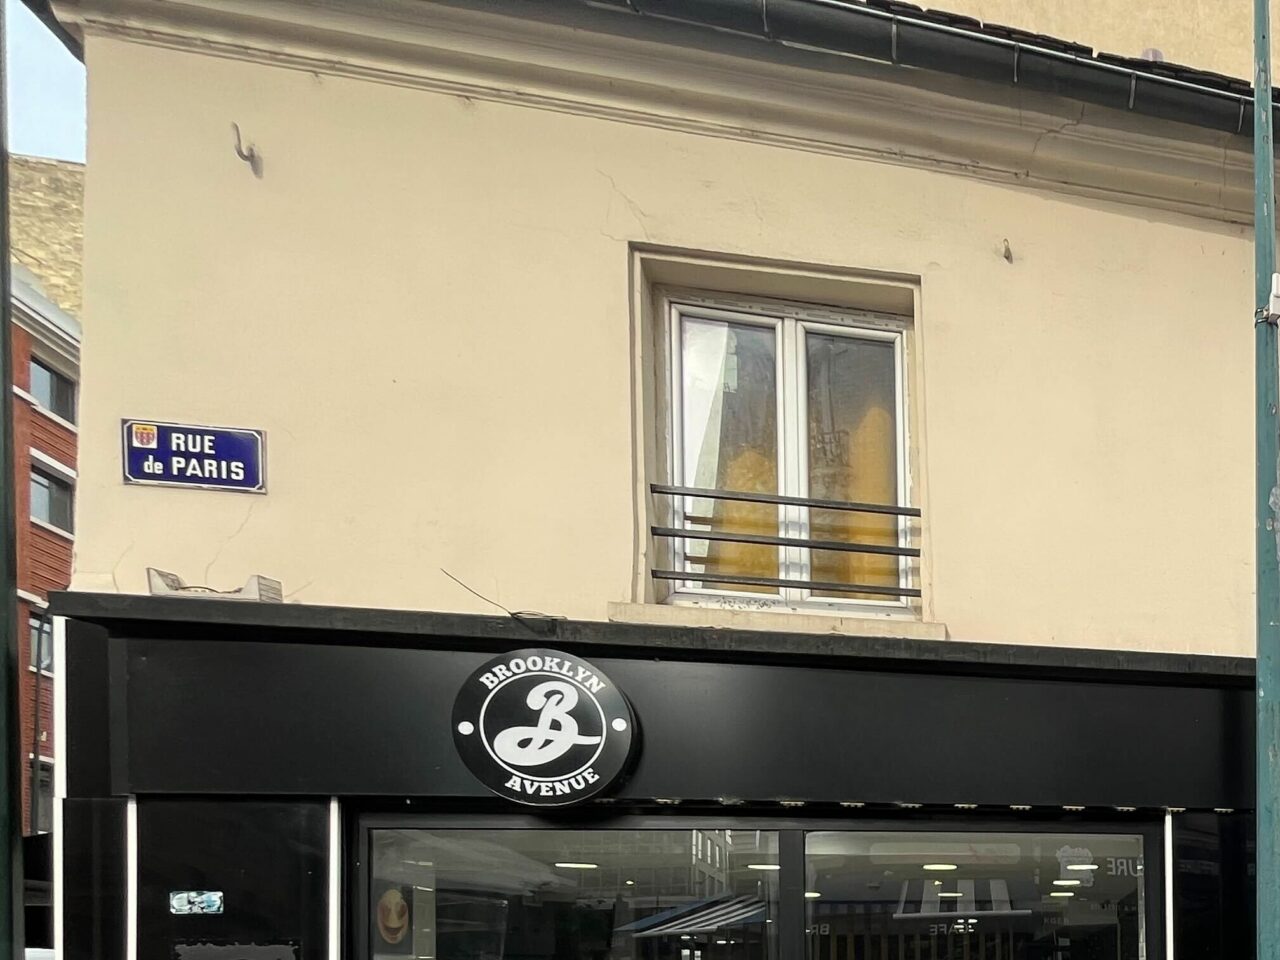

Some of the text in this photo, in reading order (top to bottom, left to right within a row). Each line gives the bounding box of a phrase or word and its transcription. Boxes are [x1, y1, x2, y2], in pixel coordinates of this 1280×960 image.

[171, 433, 215, 454] RUE
[143, 454, 244, 481] de PARIS
[479, 655, 606, 694] BROOKLYN
[504, 768, 600, 796] AVENUE
